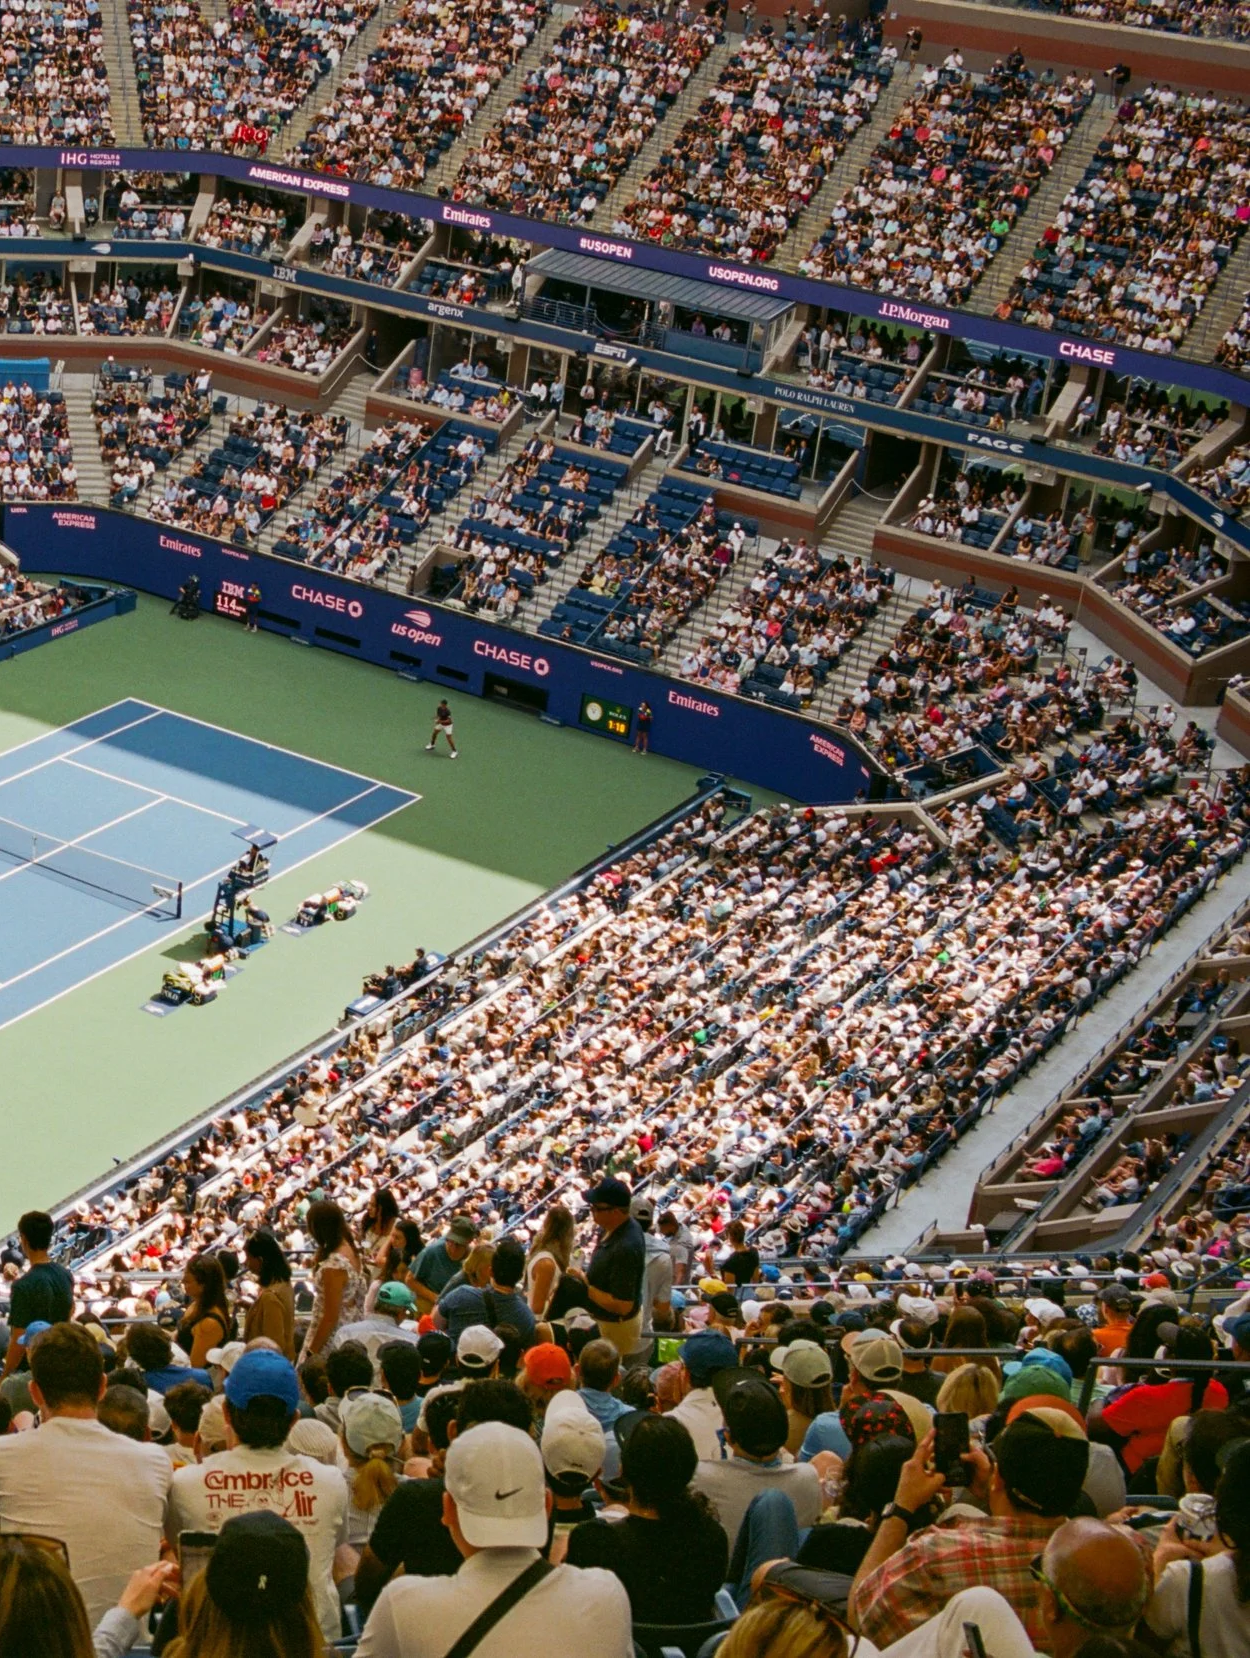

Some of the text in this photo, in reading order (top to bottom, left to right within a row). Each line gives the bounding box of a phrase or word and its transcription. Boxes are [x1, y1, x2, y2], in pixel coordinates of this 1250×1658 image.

[61, 152, 87, 165] IHG
[249, 167, 350, 197] AMERICAN EXPRESS
[442, 206, 490, 229] Emirates
[579, 237, 632, 259] #USOPEN
[272, 265, 297, 283] IBM
[708, 266, 779, 291] USOPEN.ORG
[427, 302, 464, 319] argenx
[878, 302, 950, 329] J.P.Morgan
[594, 342, 627, 359] ESPN
[1059, 342, 1116, 365] CHASE
[774, 386, 855, 414] POLO RALPH LAUREN
[52, 512, 96, 523] AMERICAN
[58, 520, 96, 530] EXPRESS
[159, 535, 202, 558] Emirates
[222, 581, 245, 599] IBM
[291, 584, 346, 613] CHASE
[217, 594, 237, 610] 114
[51, 625, 64, 637] IHG
[391, 623, 441, 647] us open
[474, 640, 532, 671] CHASE
[668, 690, 719, 717] Emirates
[810, 734, 845, 759] AMERICAN
[206, 1493, 246, 1509] THE
